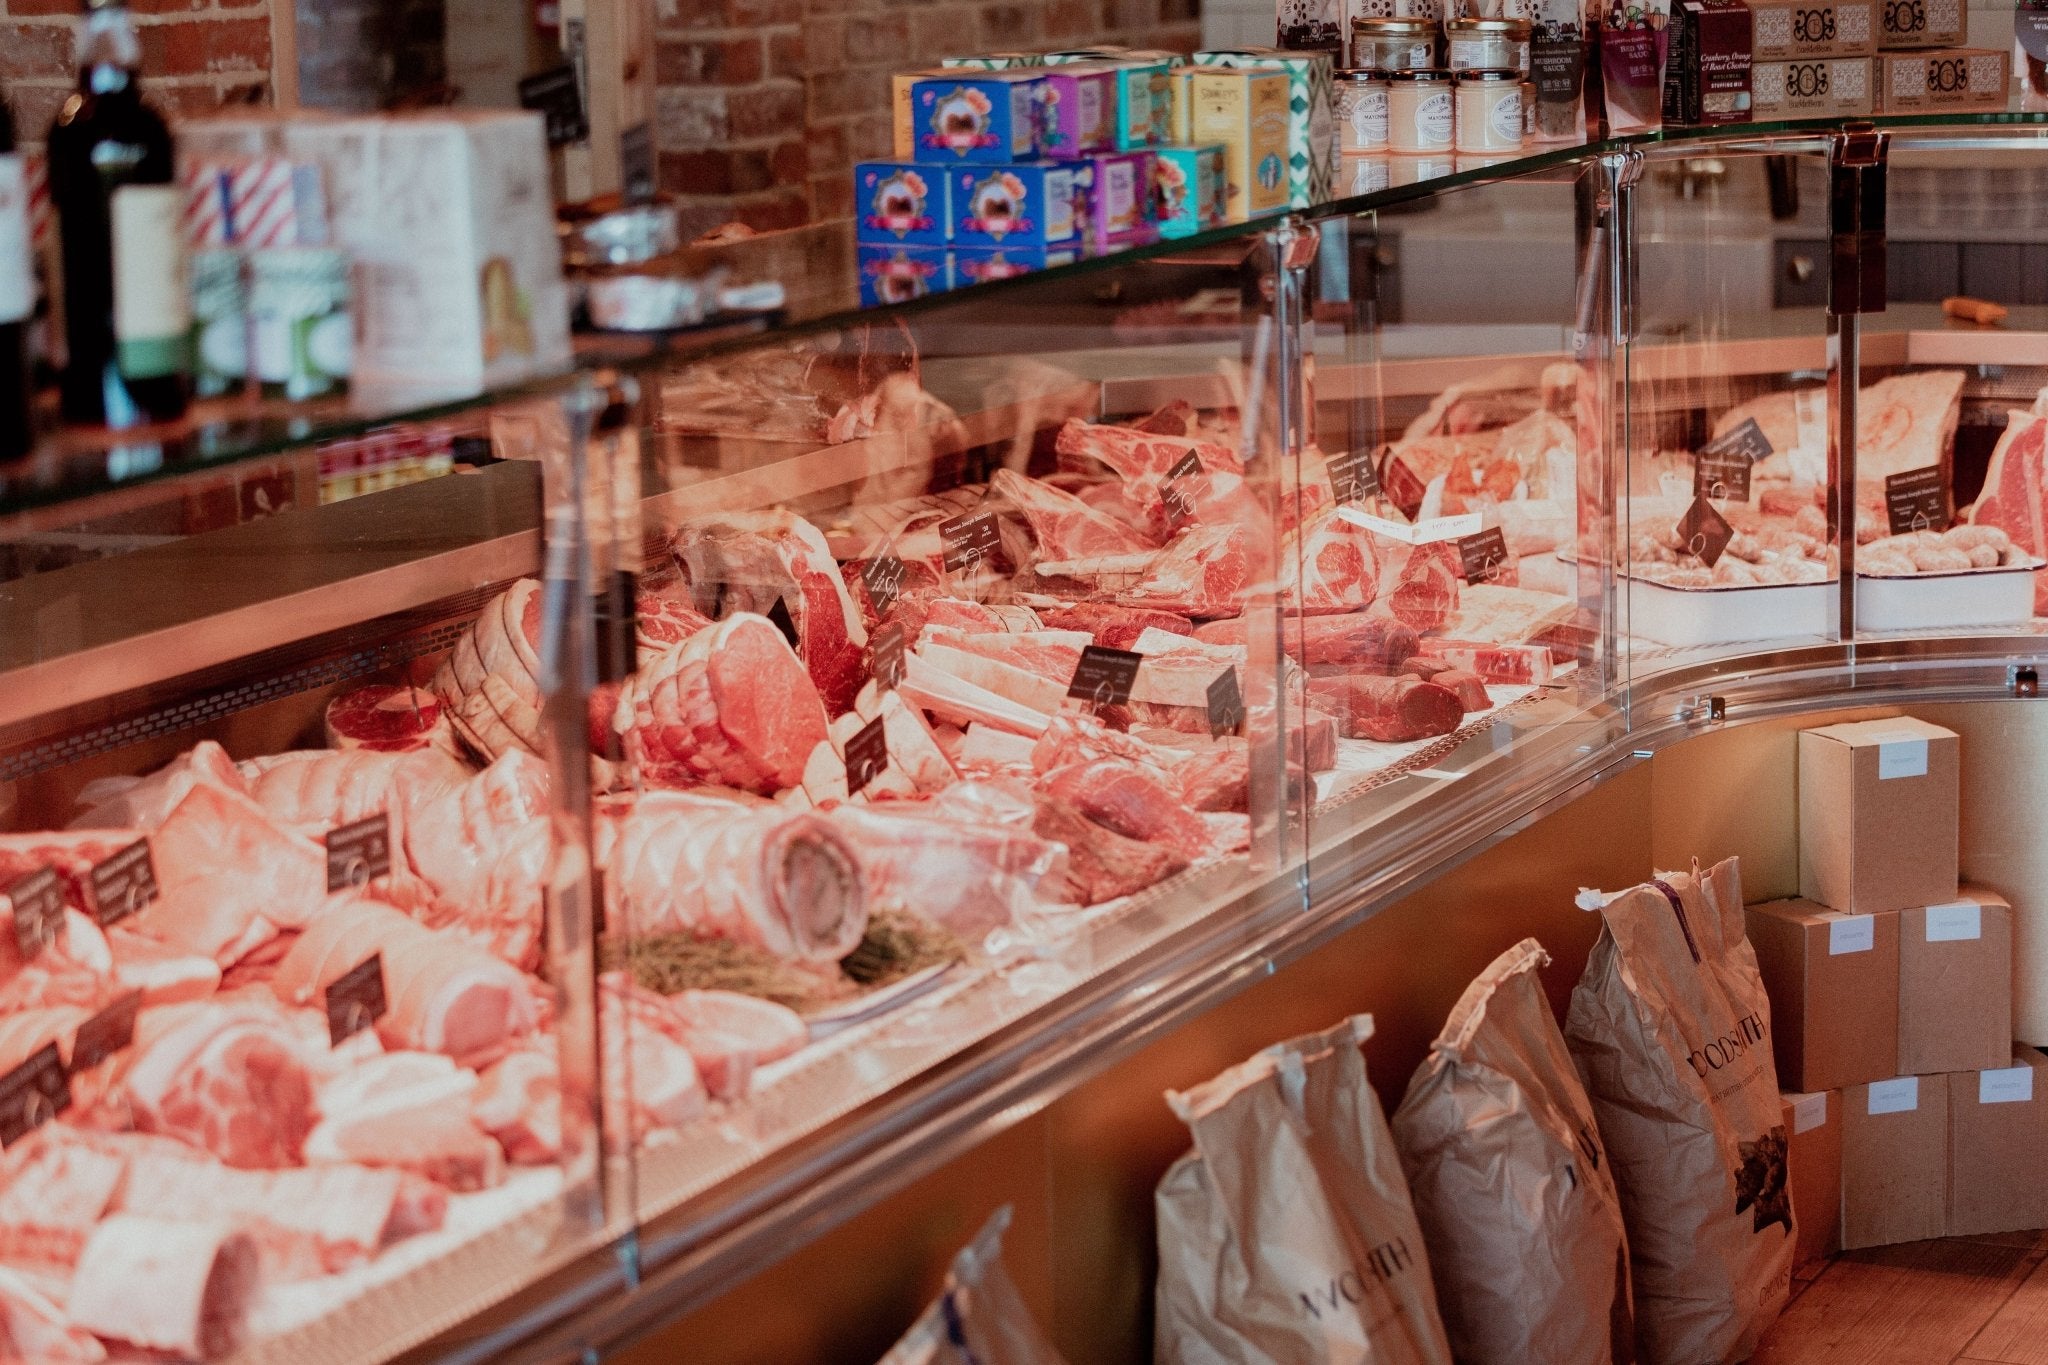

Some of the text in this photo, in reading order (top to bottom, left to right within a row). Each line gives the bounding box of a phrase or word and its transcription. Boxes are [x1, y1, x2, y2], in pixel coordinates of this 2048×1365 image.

[1533, 57, 1572, 65] MUSHROOM
[1542, 64, 1566, 72] SAUCE
[945, 523, 962, 535] Thomas
[974, 511, 992, 522] Butchery
